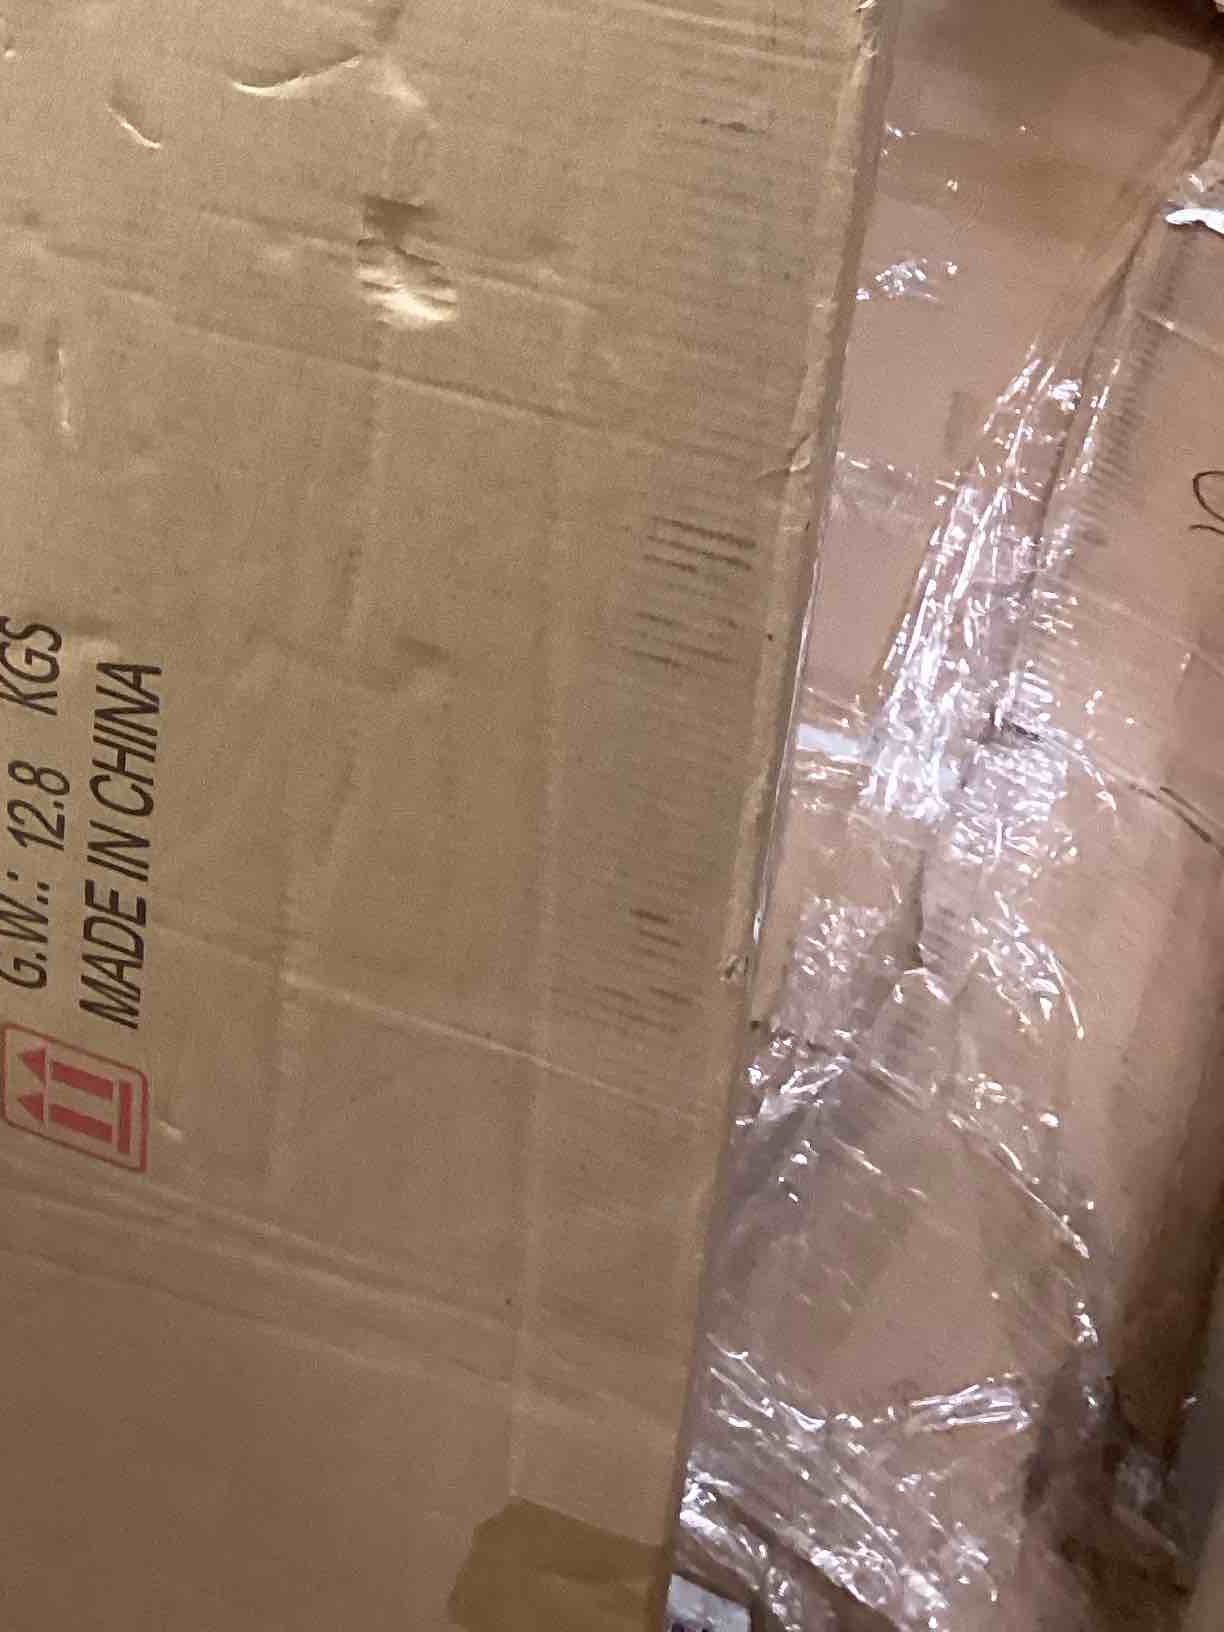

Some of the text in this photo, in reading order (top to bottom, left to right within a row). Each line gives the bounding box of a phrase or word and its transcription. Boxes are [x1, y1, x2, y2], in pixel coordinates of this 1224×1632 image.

[6, 759, 71, 852] 12.8
[78, 662, 163, 1030] MADE IN CHINA
